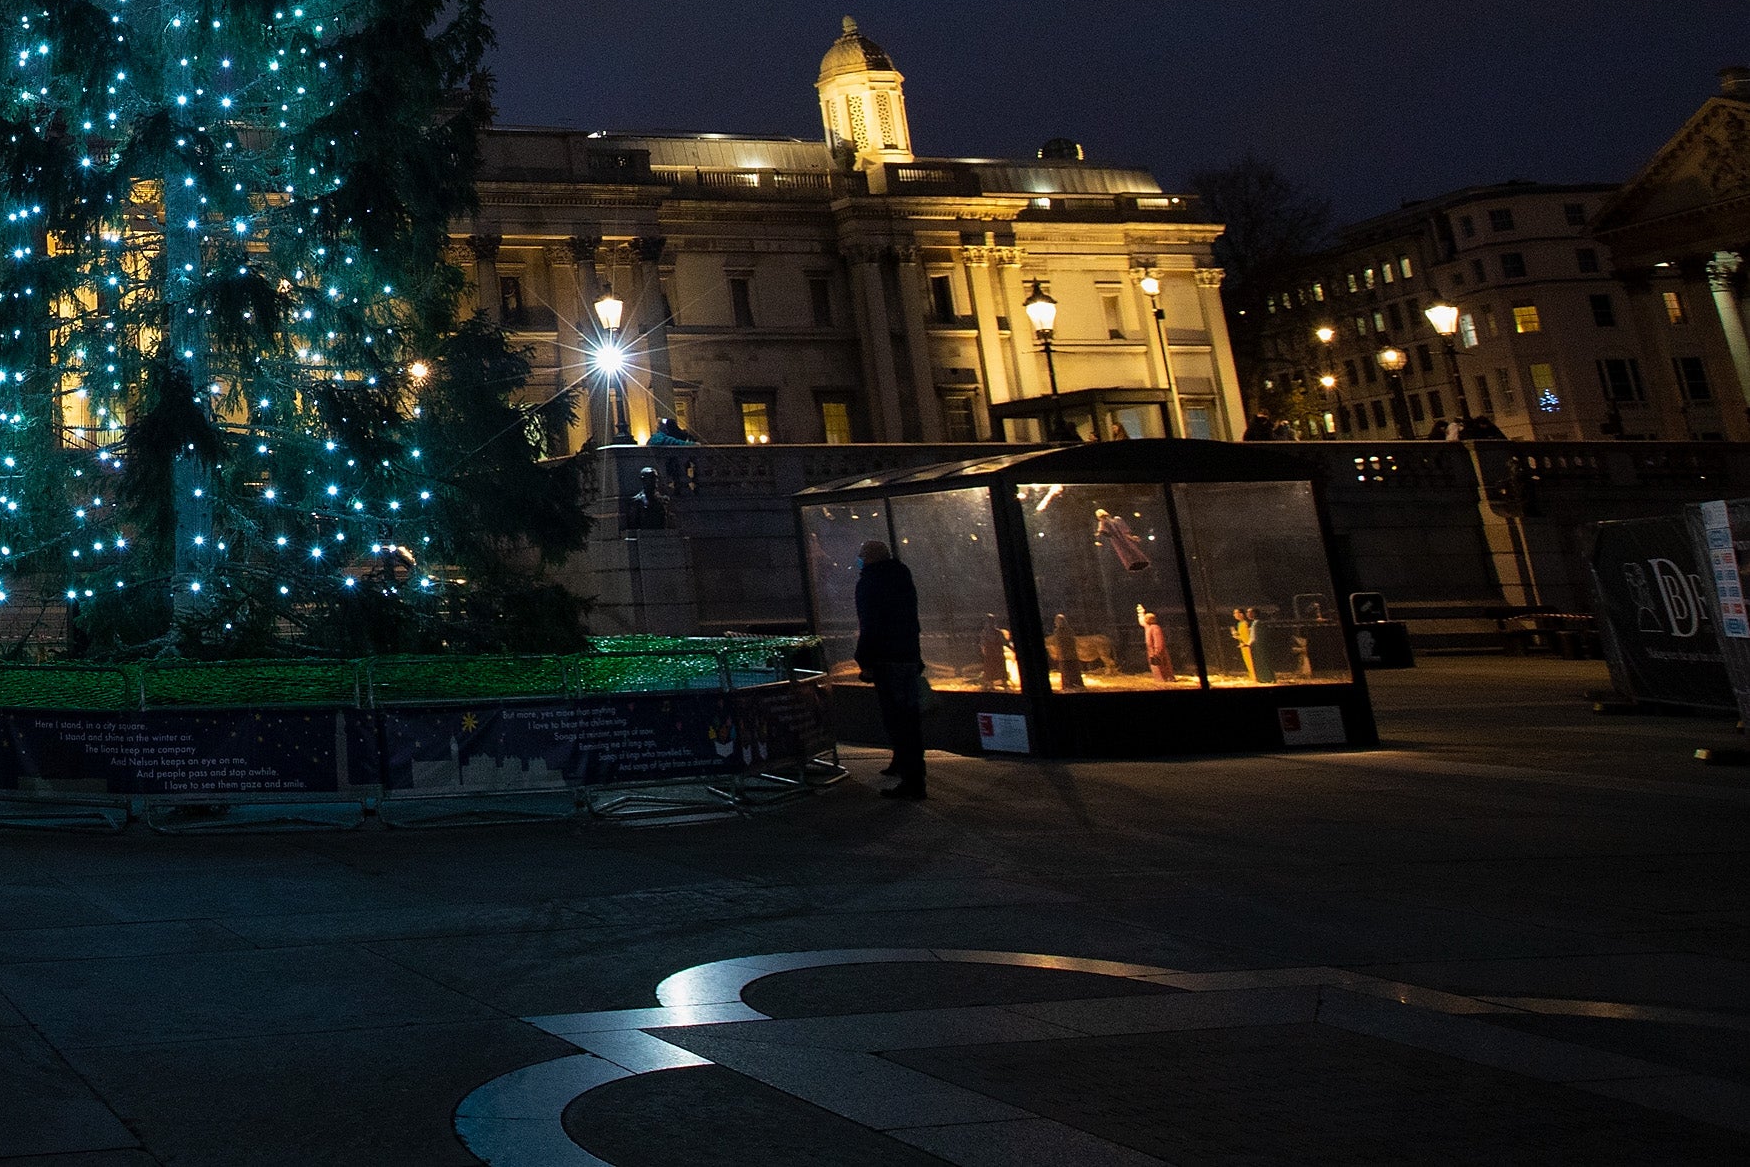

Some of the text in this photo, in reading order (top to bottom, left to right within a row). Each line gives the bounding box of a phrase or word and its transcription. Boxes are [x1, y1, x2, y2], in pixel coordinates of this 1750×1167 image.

[502, 711, 515, 719] But
[35, 720, 53, 728] Here
[86, 721, 93, 729] in
[103, 721, 116, 731] city
[533, 721, 549, 729] love
[65, 732, 86, 741] stand
[88, 733, 103, 741] and
[105, 733, 124, 742] shine
[126, 734, 134, 742] in
[136, 733, 149, 742] the
[152, 733, 178, 742] winter
[554, 732, 577, 742] Songs
[85, 744, 98, 753] The
[100, 744, 118, 753] lions
[120, 744, 140, 756] keep
[110, 757, 126, 766] And
[129, 757, 159, 766] Nelson
[161, 757, 186, 768] keeps
[188, 758, 199, 766] an
[201, 758, 216, 767] eye
[136, 769, 154, 778] And
[156, 769, 186, 780] people
[188, 770, 208, 779] pass
[210, 768, 227, 777] and
[229, 768, 246, 779] stop
[170, 781, 188, 790] love
[218, 780, 238, 789] them
[241, 782, 262, 790] gaze
[264, 779, 280, 788] and
